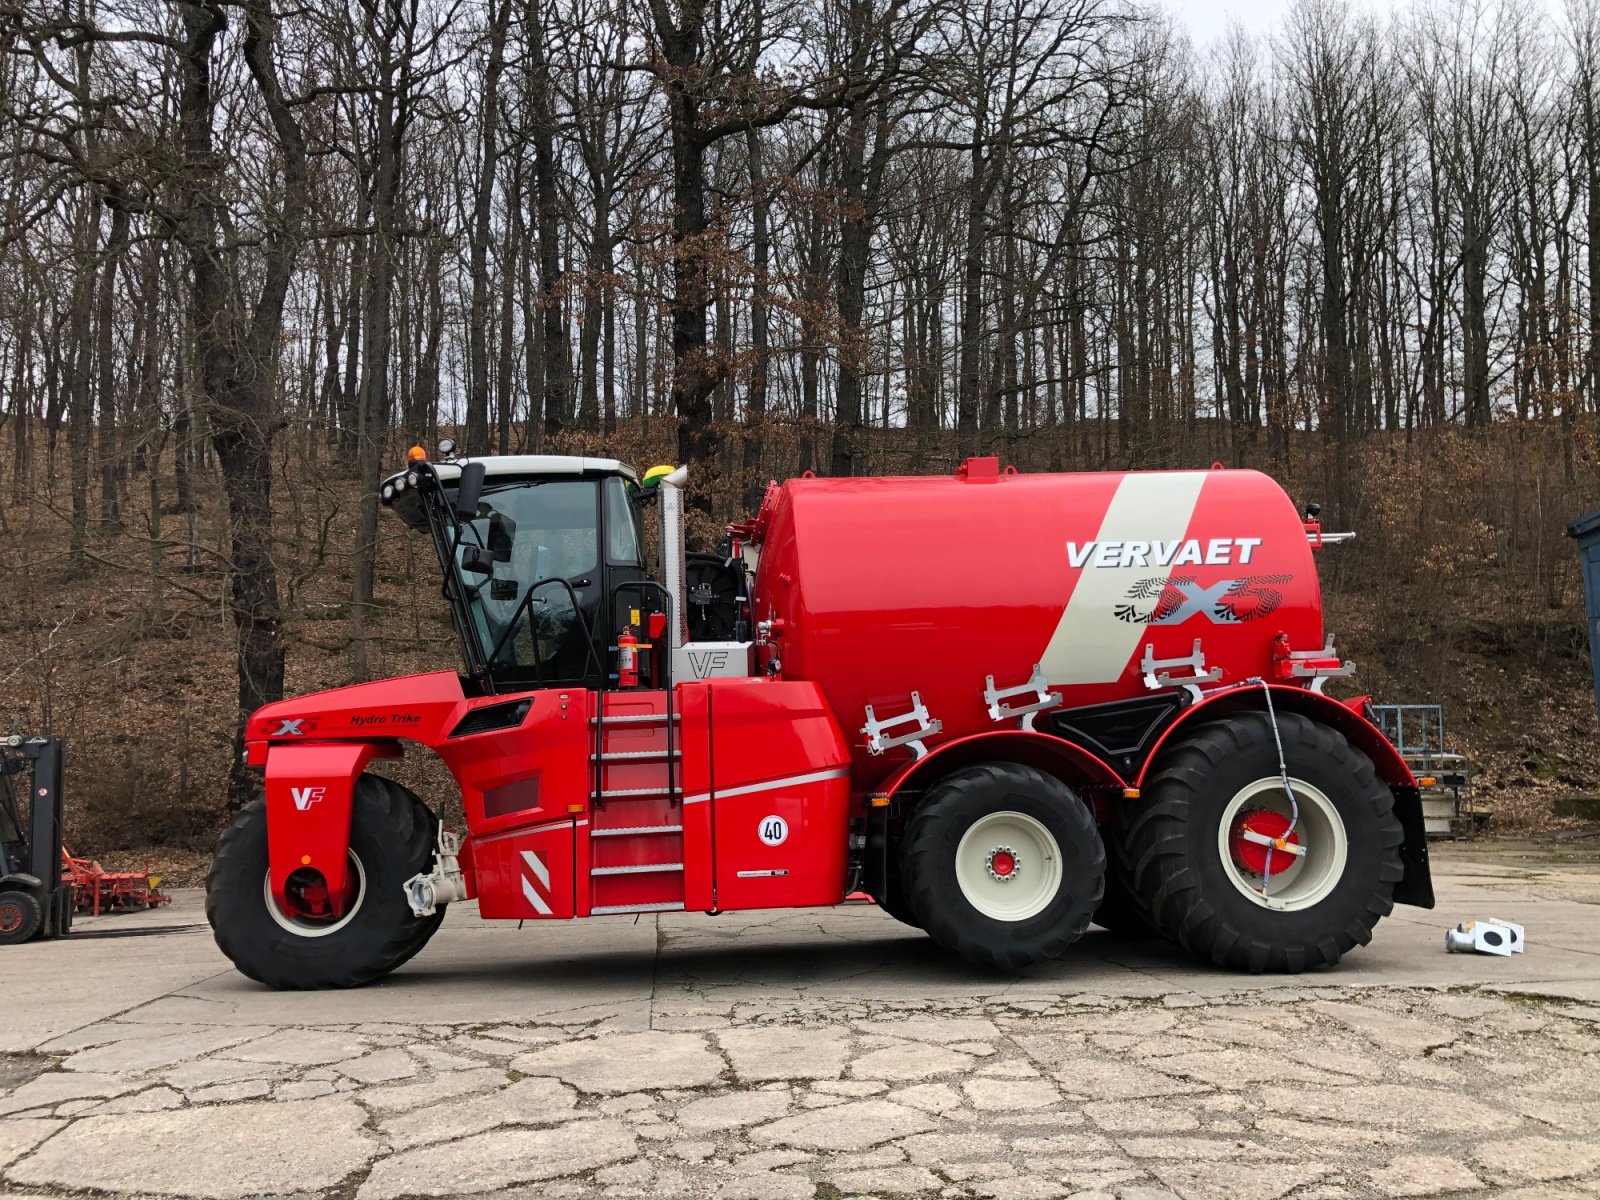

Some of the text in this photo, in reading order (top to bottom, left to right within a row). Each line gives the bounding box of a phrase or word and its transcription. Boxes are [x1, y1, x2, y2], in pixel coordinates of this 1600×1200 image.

[1066, 538, 1262, 568] VERVAET
[688, 651, 728, 679] VF
[350, 713, 421, 726] Hydro Trike
[291, 787, 326, 810] VF
[764, 821, 782, 840] 40
